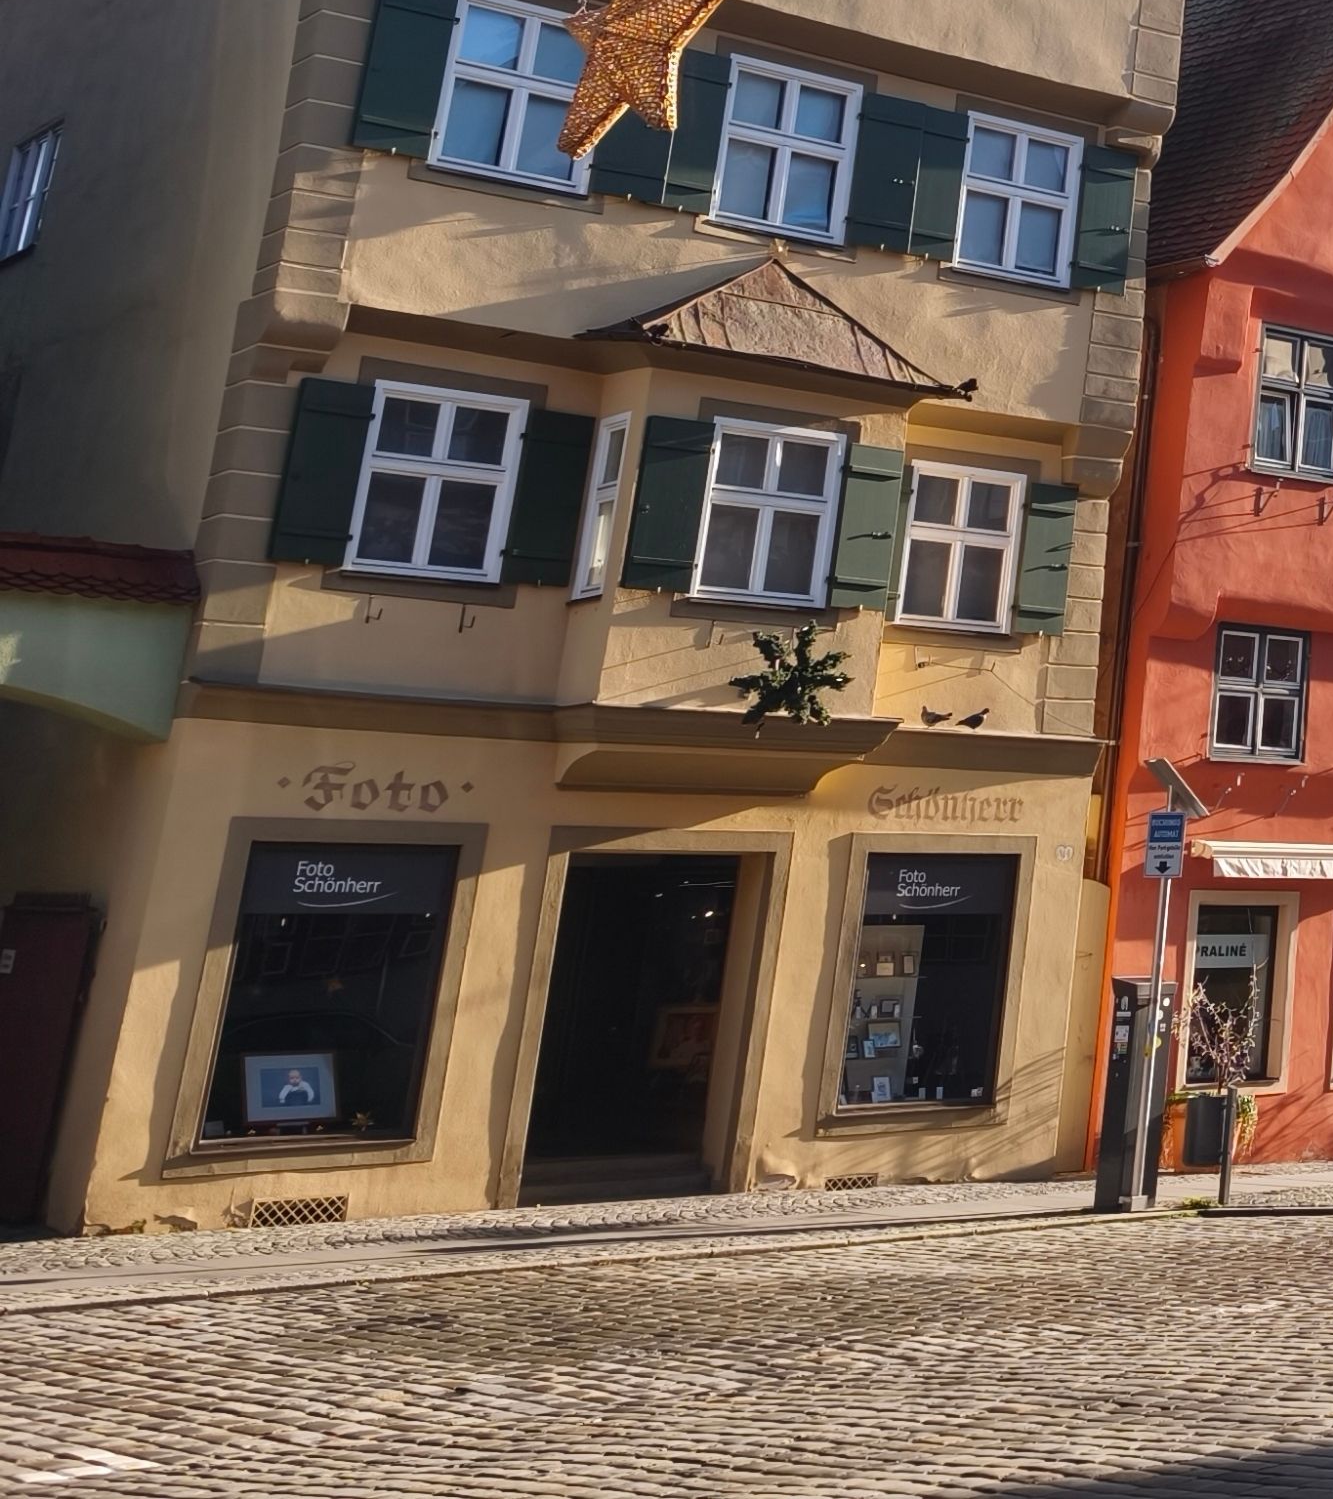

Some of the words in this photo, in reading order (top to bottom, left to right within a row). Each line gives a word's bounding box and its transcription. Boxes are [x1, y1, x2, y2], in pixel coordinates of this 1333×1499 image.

[302, 761, 449, 812] Foto
[867, 784, 1024, 825] Schönherr
[296, 861, 334, 877] Foto
[899, 869, 926, 883] Foto
[293, 876, 382, 893] Schönherr
[896, 882, 961, 897] Schönherr
